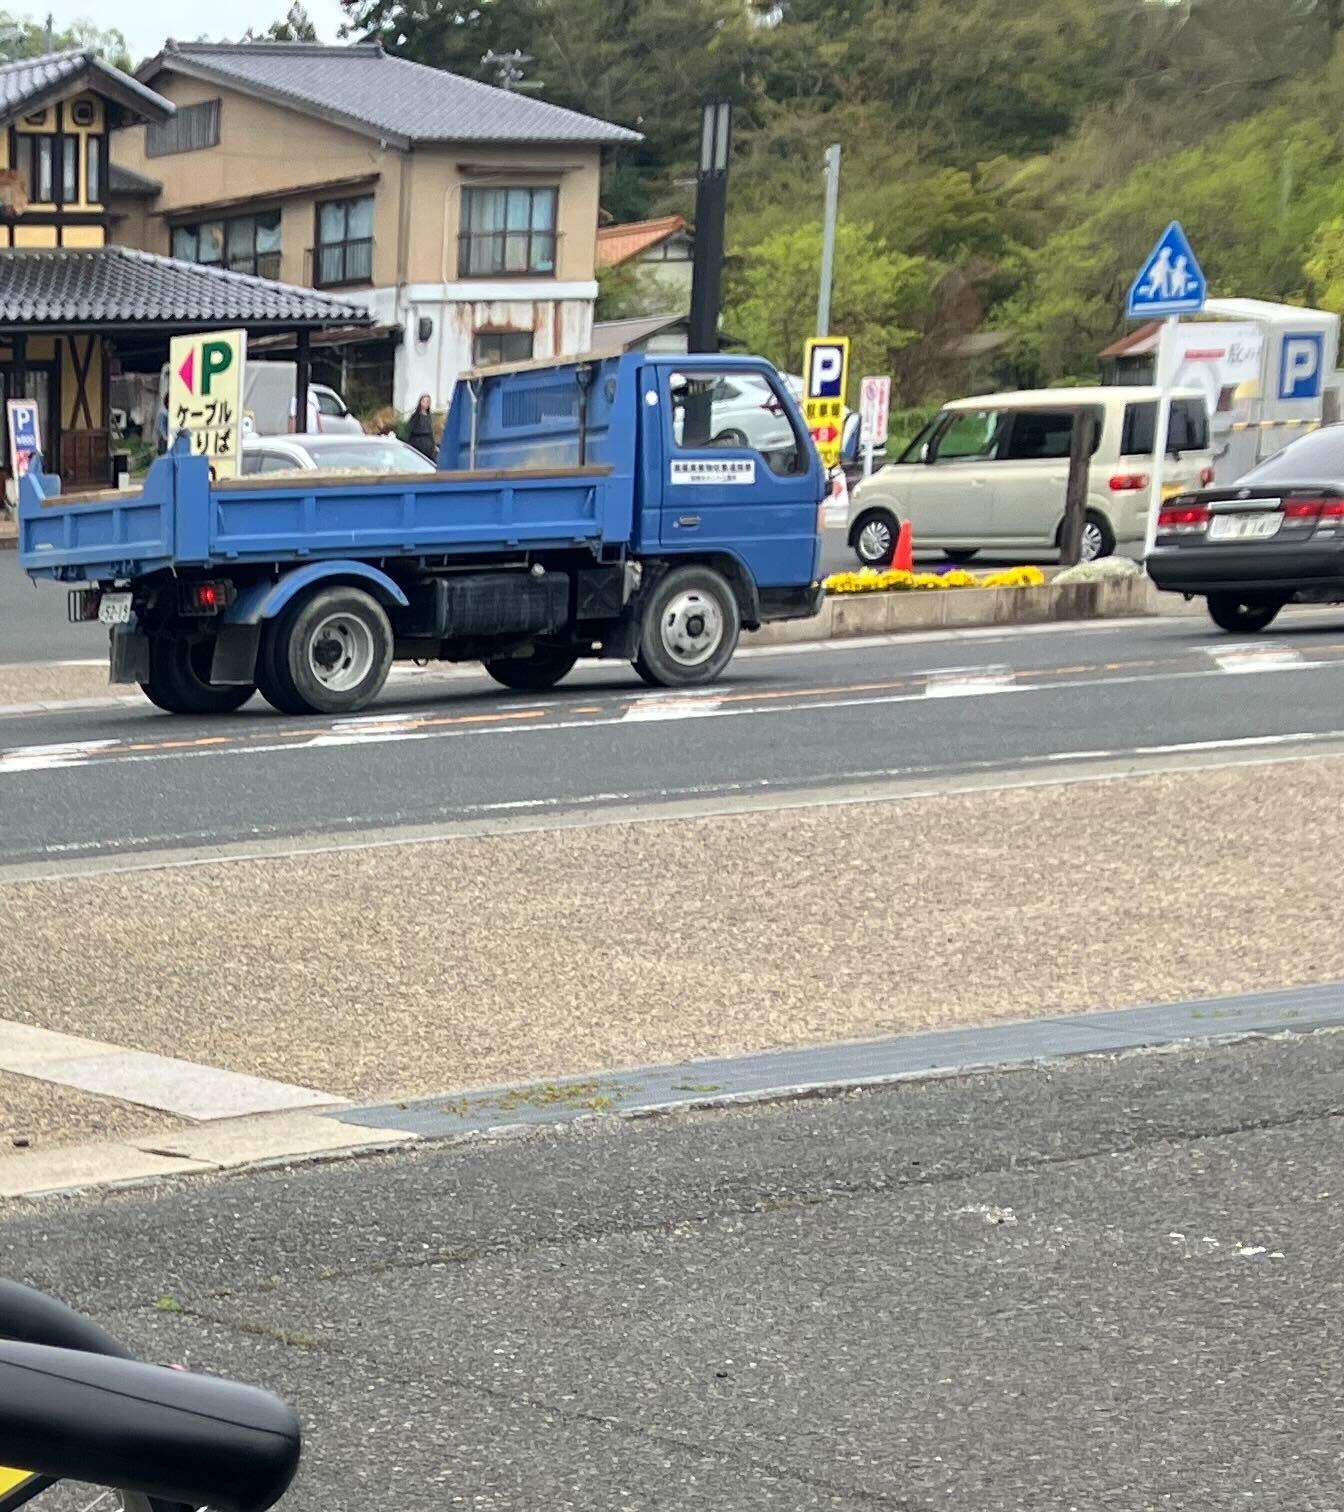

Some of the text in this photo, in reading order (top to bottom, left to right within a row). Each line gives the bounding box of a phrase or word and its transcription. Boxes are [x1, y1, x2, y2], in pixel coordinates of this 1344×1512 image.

[201, 341, 233, 396] P
[812, 347, 841, 396] P
[1283, 339, 1318, 394] P
[17, 408, 30, 430] P
[177, 400, 232, 427] ケーブル
[807, 403, 840, 417] 駐車場
[196, 428, 230, 455] りば
